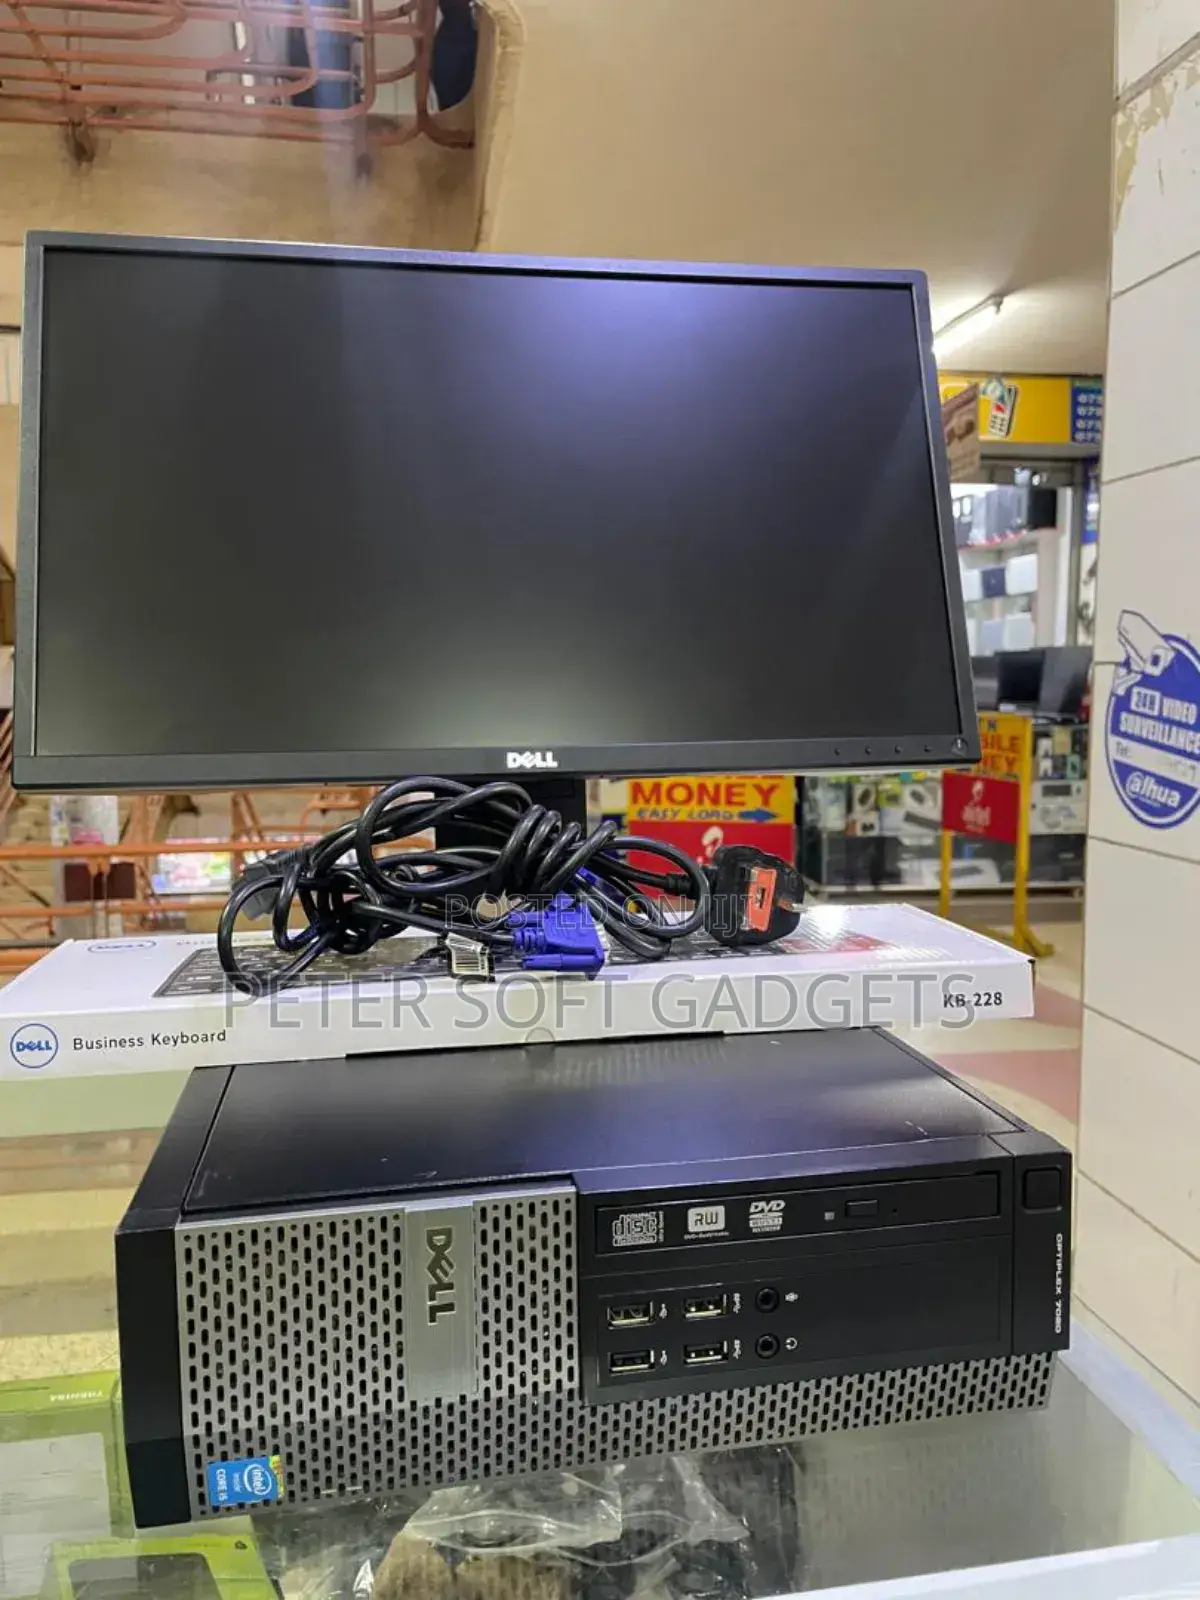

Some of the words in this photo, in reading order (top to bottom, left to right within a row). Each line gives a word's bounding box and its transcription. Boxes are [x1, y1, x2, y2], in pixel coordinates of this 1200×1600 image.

[506, 750, 558, 769] DELL
[631, 781, 780, 807] MONEY
[15, 1040, 52, 1053] DELL
[73, 1036, 145, 1051] Business
[151, 1029, 227, 1047] Keyboard
[749, 1200, 786, 1214] DVD
[694, 1211, 719, 1227] RW
[1055, 1233, 1063, 1295] OPTIPLEX
[426, 1226, 456, 1326] DELL
[217, 1469, 228, 1491] CORE
[252, 1469, 266, 1491] intel
